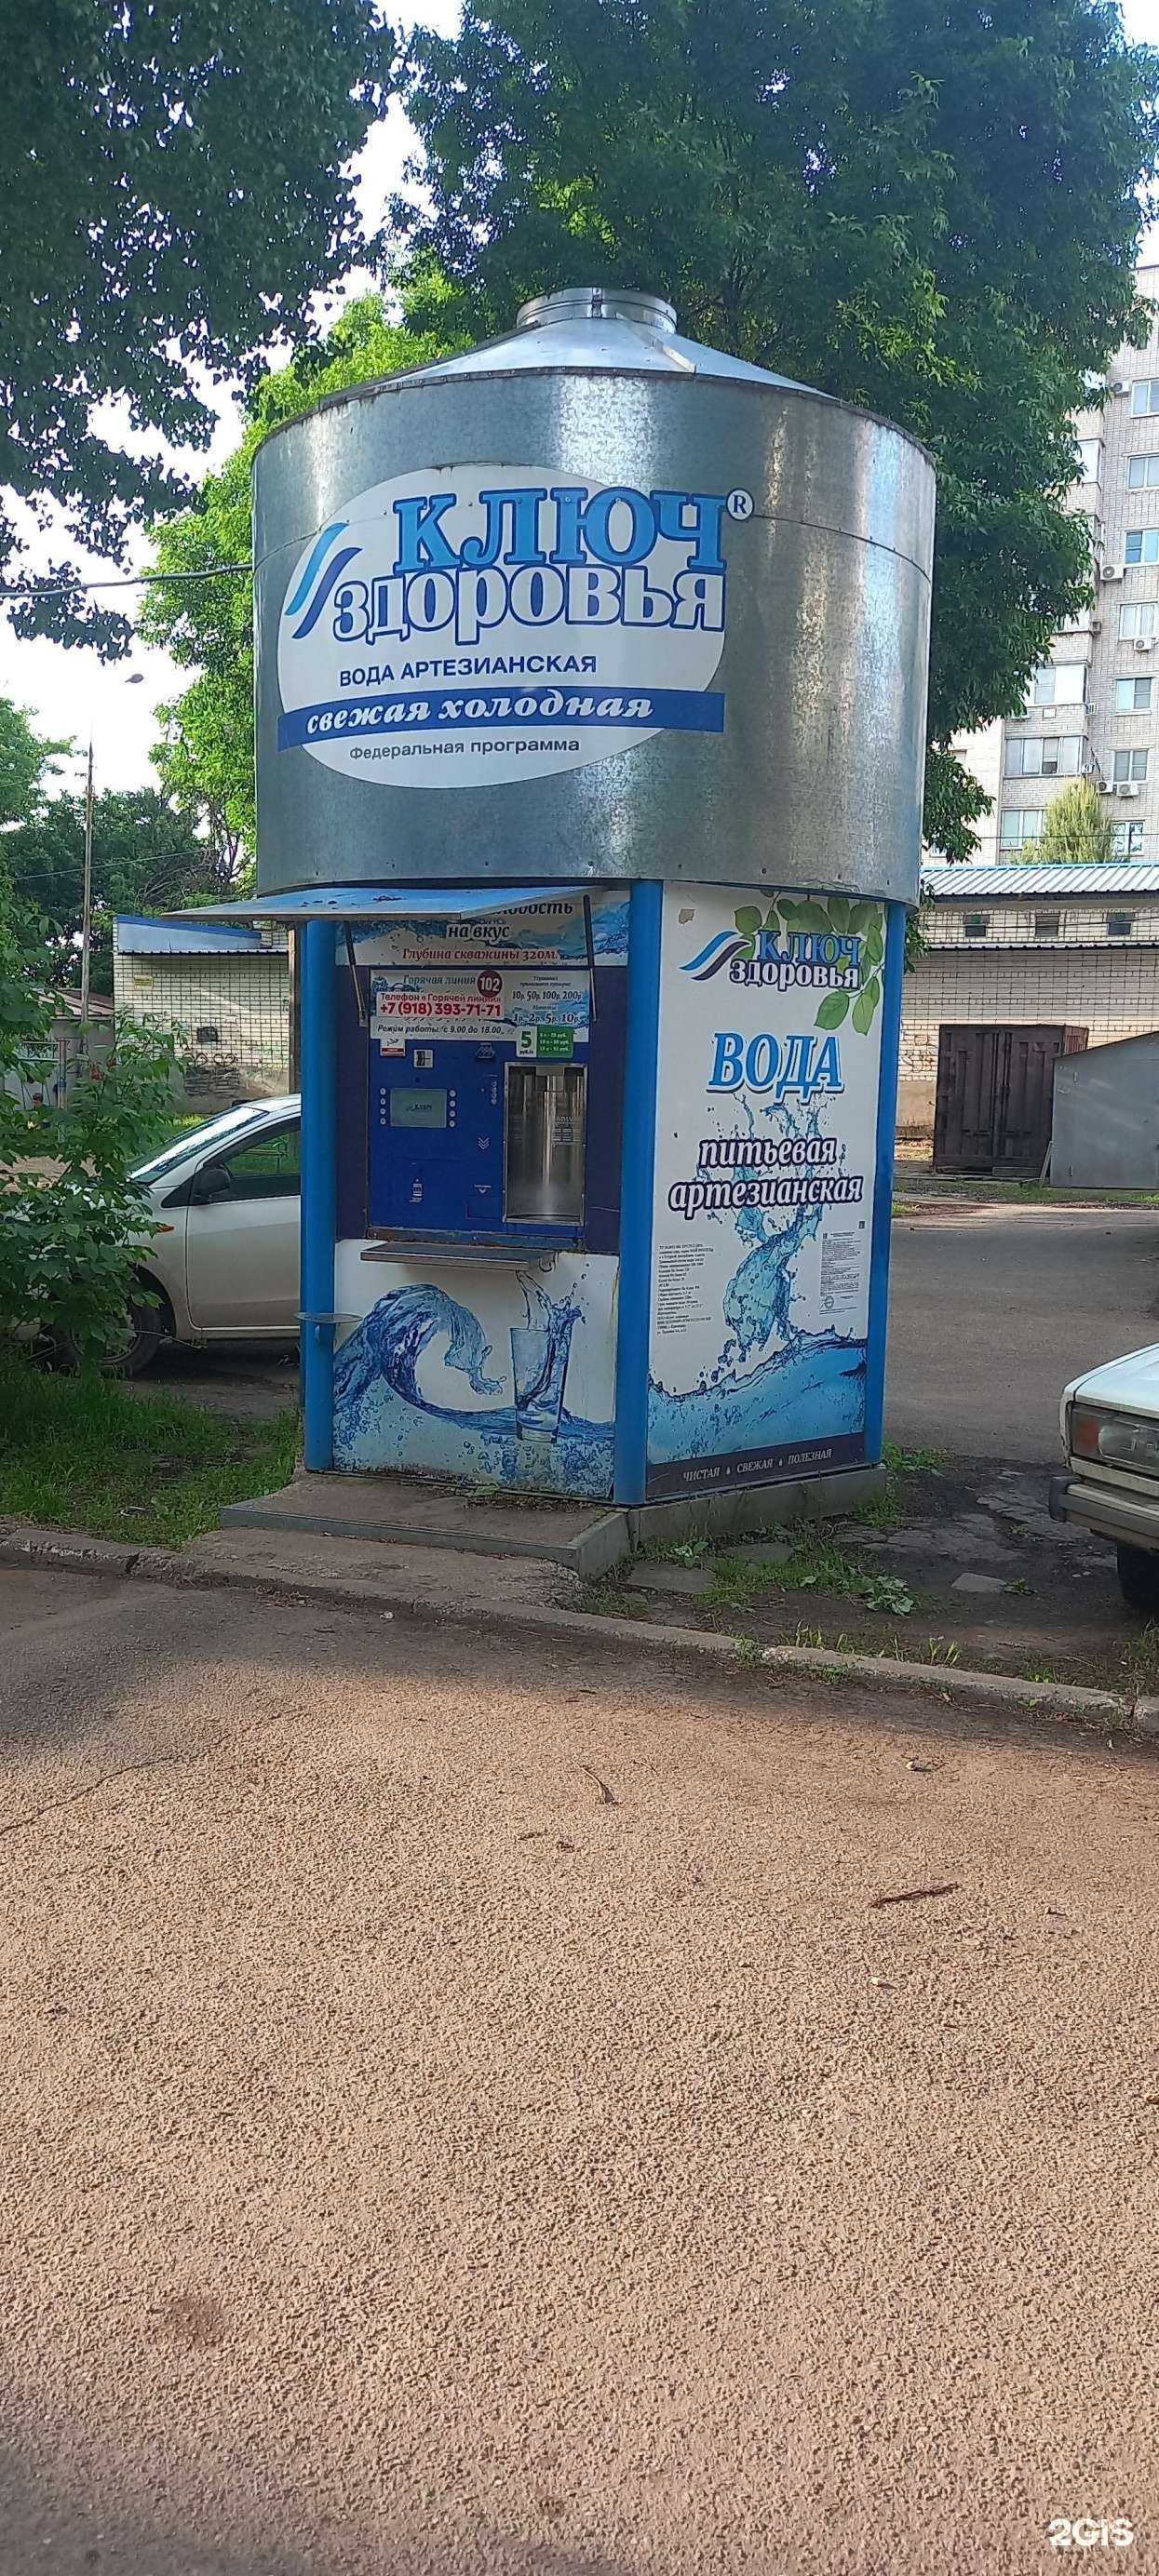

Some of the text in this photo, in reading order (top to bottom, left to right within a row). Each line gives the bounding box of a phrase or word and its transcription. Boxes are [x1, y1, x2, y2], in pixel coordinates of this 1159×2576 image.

[393, 487, 727, 573] КЛЮЧ
[340, 655, 597, 687] ВОДА АРТЕЗИАНСКАЯ
[306, 690, 654, 734] свежая холодная
[350, 737, 580, 760] Федеральная программа
[448, 924, 510, 943] на вкус
[402, 948, 451, 961] Глубина
[454, 949, 519, 960] скважины
[757, 930, 861, 966] КЛЮЧ
[403, 975, 476, 986] Горячая линия
[479, 976, 500, 991] 102
[380, 1002, 501, 1016] +7 (918) 393-71-71
[381, 993, 420, 1002] Телефон
[377, 1025, 404, 1033] Режим
[450, 1026, 466, 1034] 9.00
[468, 1025, 479, 1033] до
[520, 1030, 532, 1048] 5
[708, 1031, 842, 1104] ВОДА
[698, 1137, 837, 1167] питьевая
[668, 1176, 863, 1220] артезианская
[682, 1449, 833, 1482] ЧИСТАЯ СВЕЖАЯ ПОЛЕЗНАЯ
